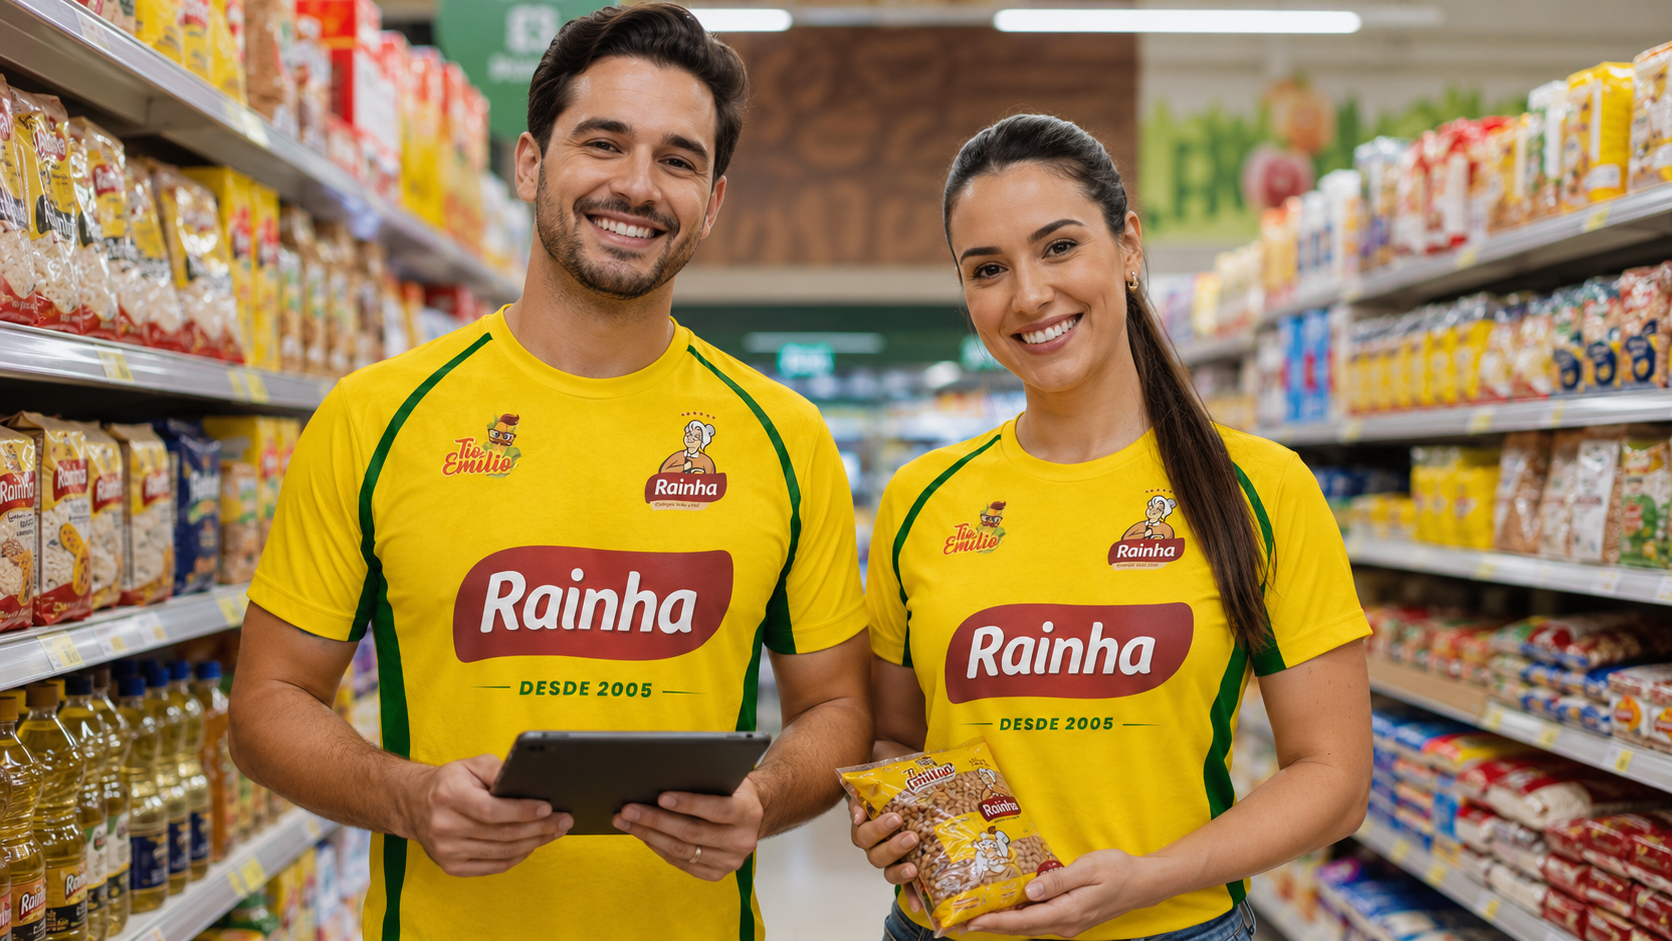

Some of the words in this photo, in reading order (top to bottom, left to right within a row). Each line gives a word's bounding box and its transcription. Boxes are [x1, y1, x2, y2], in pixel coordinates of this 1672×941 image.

[654, 478, 718, 496] Rainha
[1116, 543, 1176, 559] Rainha
[479, 567, 698, 635] Rainha
[966, 620, 1157, 680] Rainha
[519, 680, 591, 697] DESDE
[597, 682, 653, 698] 2005
[999, 717, 1060, 731] DESDE
[1065, 716, 1115, 731] 2005
